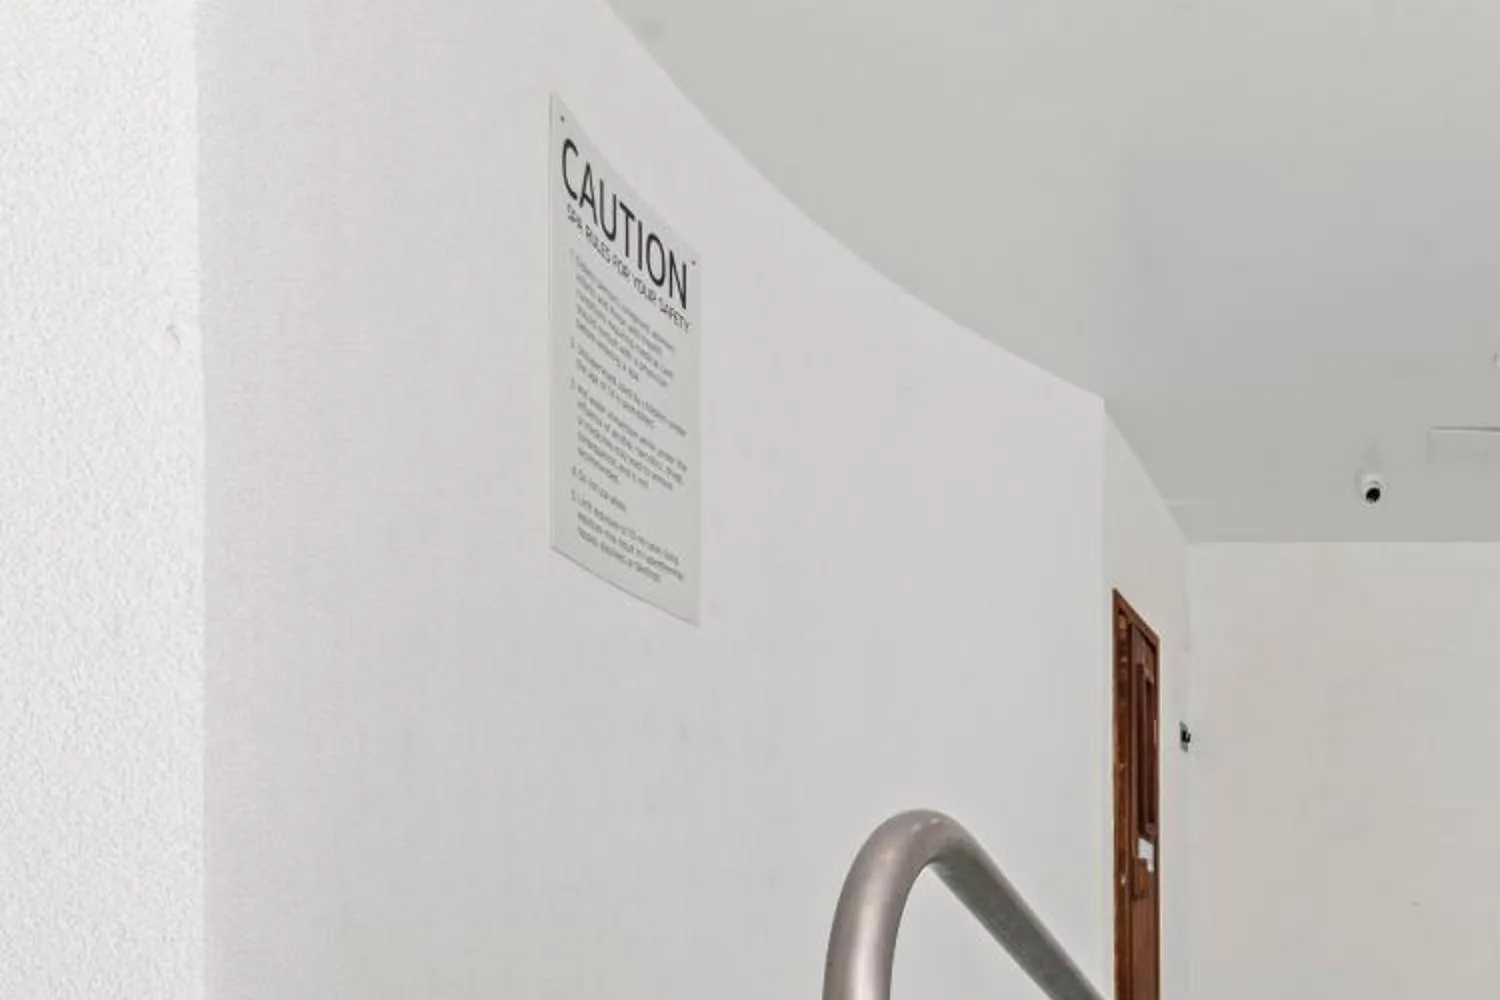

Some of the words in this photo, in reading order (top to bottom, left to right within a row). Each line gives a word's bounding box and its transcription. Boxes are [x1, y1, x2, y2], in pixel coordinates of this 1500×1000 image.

[561, 138, 688, 310] CAUTION
[584, 223, 611, 265] RULES
[612, 253, 631, 279] FOR
[631, 273, 657, 303] YOUR
[658, 296, 690, 334] SAFETY
